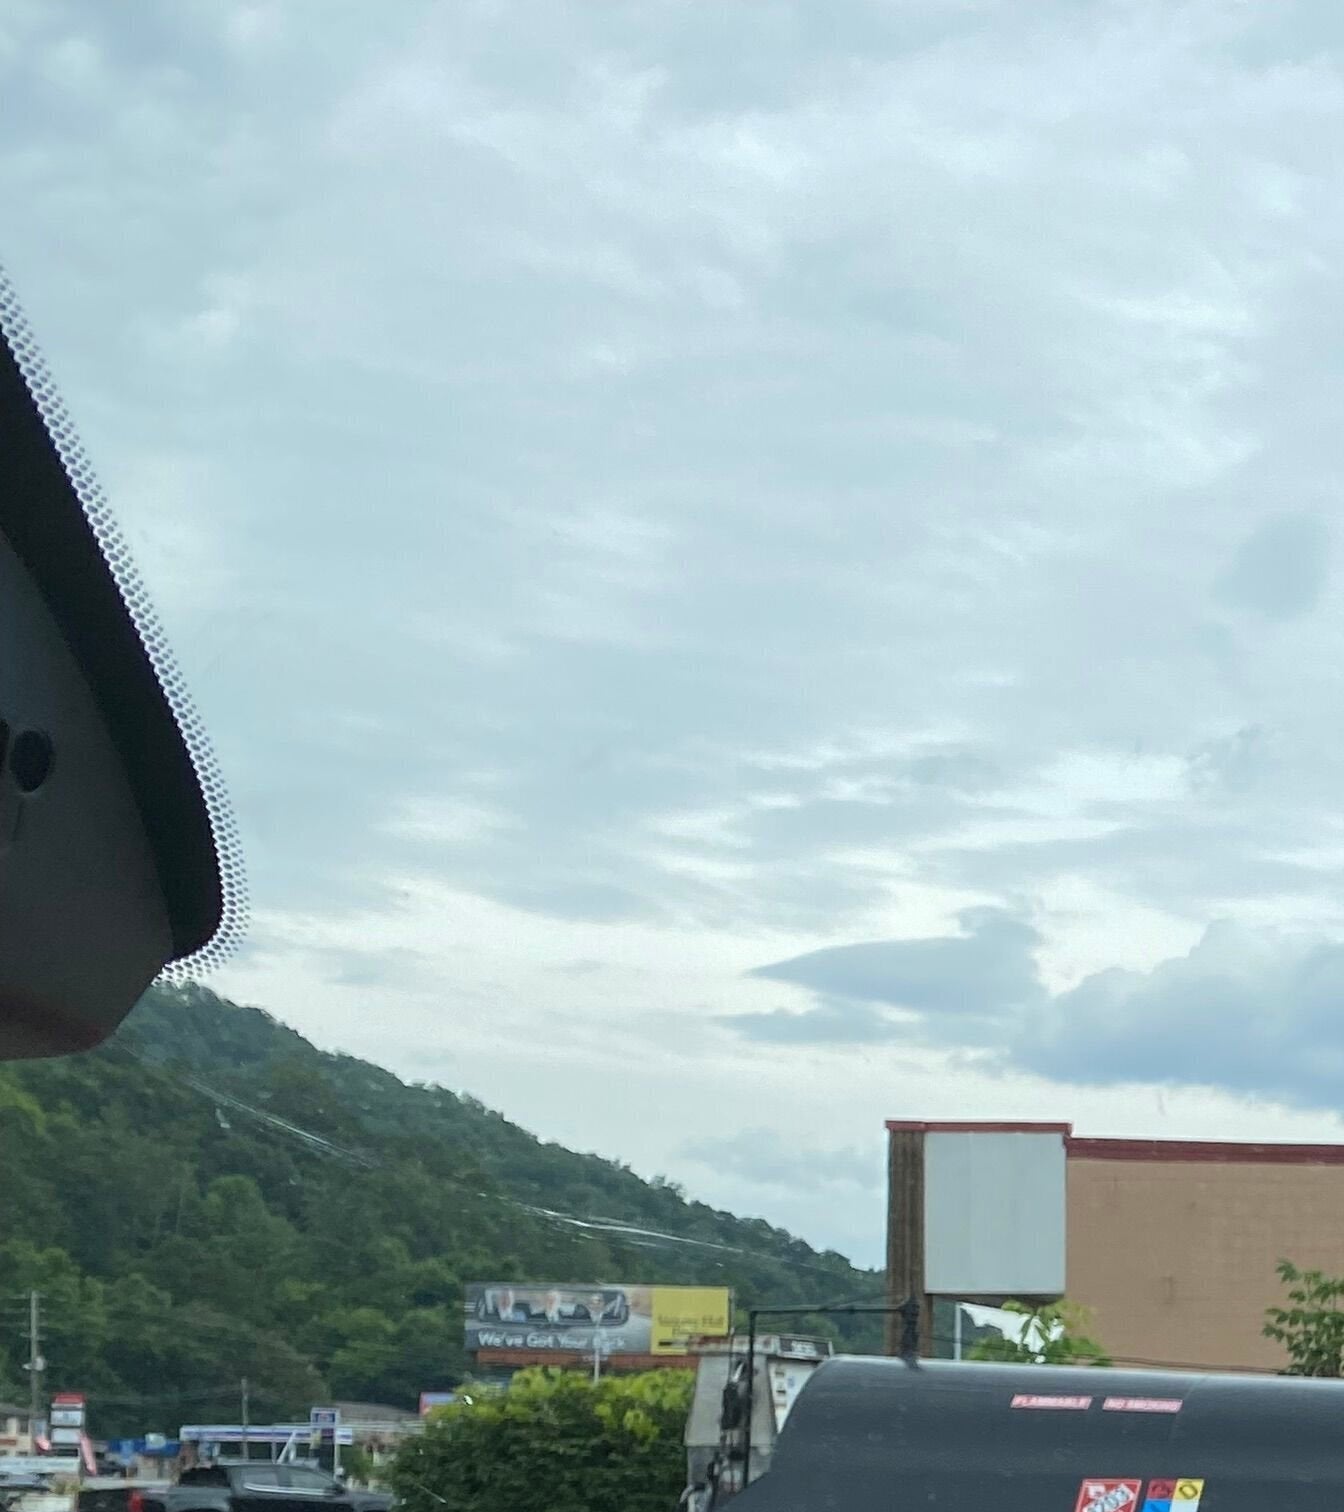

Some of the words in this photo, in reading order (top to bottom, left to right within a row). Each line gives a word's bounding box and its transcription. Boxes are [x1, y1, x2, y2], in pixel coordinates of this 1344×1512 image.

[478, 1331, 523, 1347] We've
[527, 1332, 553, 1348] Got
[557, 1333, 588, 1349] Your
